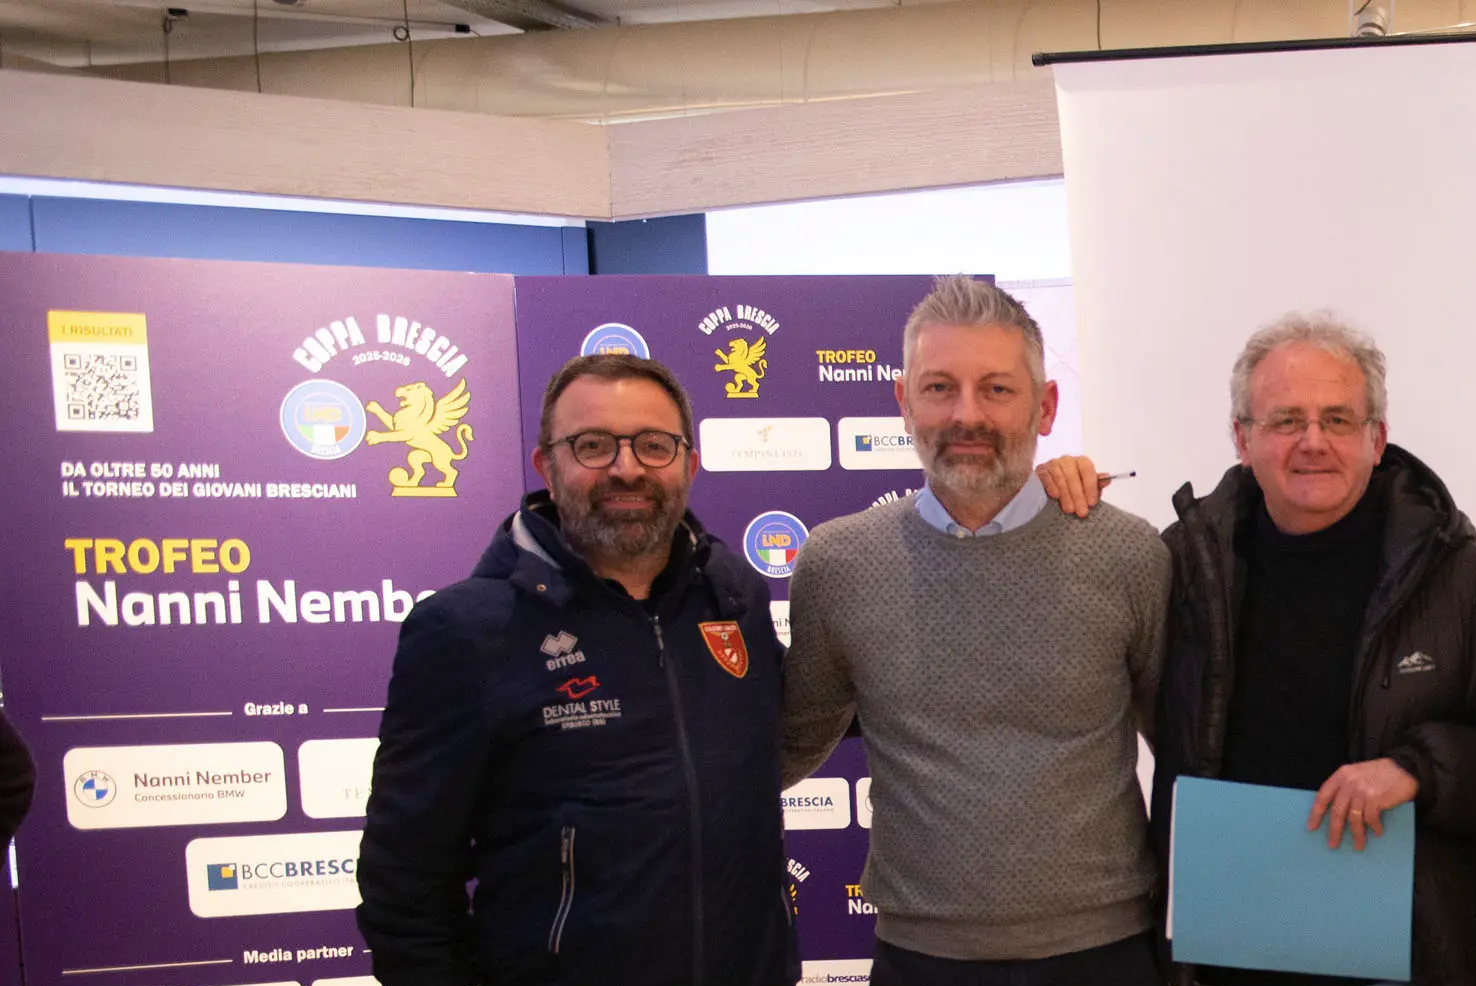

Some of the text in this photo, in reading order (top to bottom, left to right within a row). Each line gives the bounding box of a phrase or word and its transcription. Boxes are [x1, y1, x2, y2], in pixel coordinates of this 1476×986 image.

[697, 304, 781, 336] COPPA BRESCIA
[70, 324, 133, 338] RISULTATI
[292, 313, 470, 379] COPPA BRESCIA
[815, 349, 877, 364] TROFEO
[818, 364, 873, 382] Nanni
[60, 462, 220, 479] DA OLTRE 50 ANNI
[62, 482, 357, 499] IL TORNEO DEI GIOVANI BRESCIANI
[761, 533, 792, 548] LND
[64, 537, 251, 575] TROFEO
[75, 579, 437, 627] Nanni Nemb
[244, 701, 309, 717] Grazie a
[543, 698, 621, 718] DENTAL STYLE
[133, 768, 272, 788] Nanni Nember
[217, 789, 246, 799] BMW
[781, 796, 834, 808] BRESCIA
[241, 858, 355, 880] BCCBRESC
[786, 858, 811, 883] SCIA
[243, 945, 354, 964] Media partner
